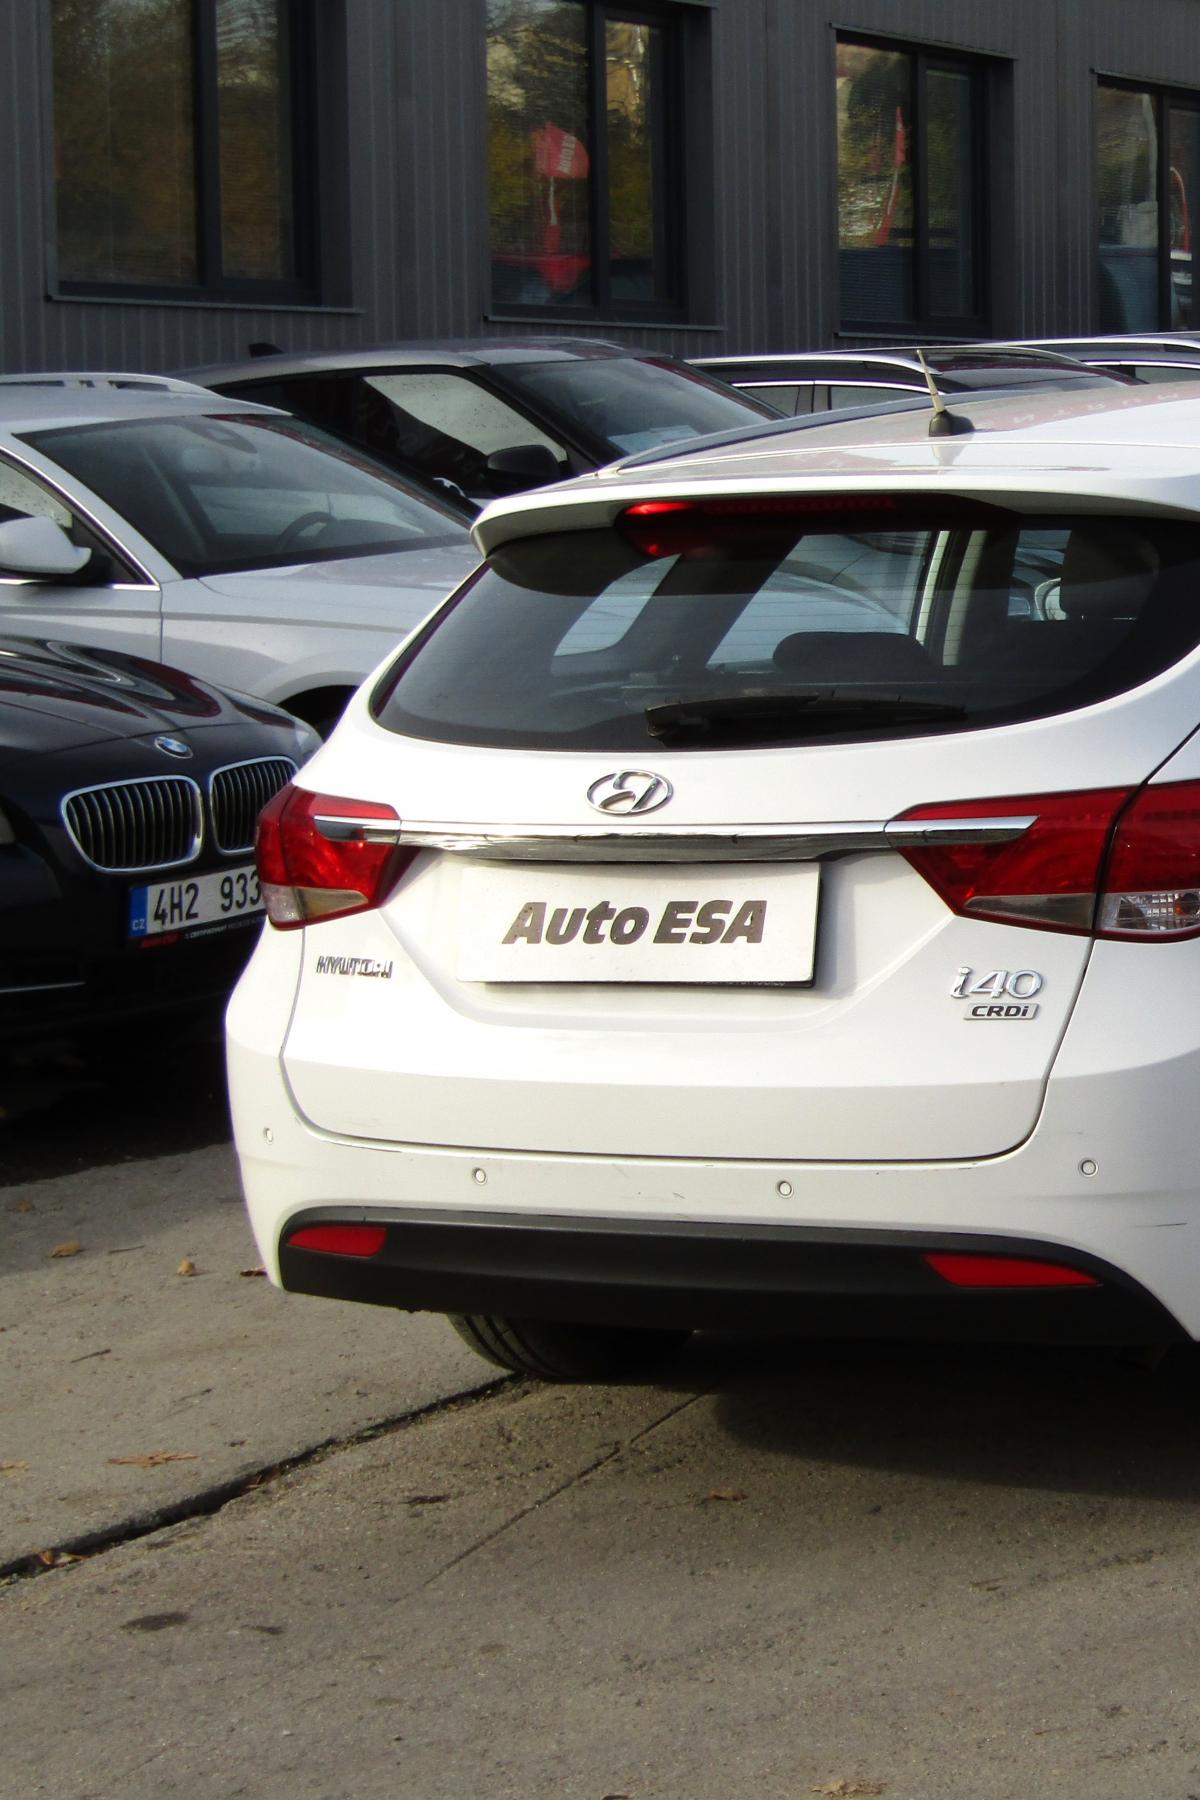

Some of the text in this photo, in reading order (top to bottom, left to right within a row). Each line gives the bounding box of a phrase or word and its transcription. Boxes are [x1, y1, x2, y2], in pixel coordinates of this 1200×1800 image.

[154, 882, 200, 926] 4H2
[132, 918, 145, 931] CZ
[501, 899, 768, 946] Auto ESA
[949, 966, 1044, 999] i40
[971, 1005, 1030, 1018] CRDi
